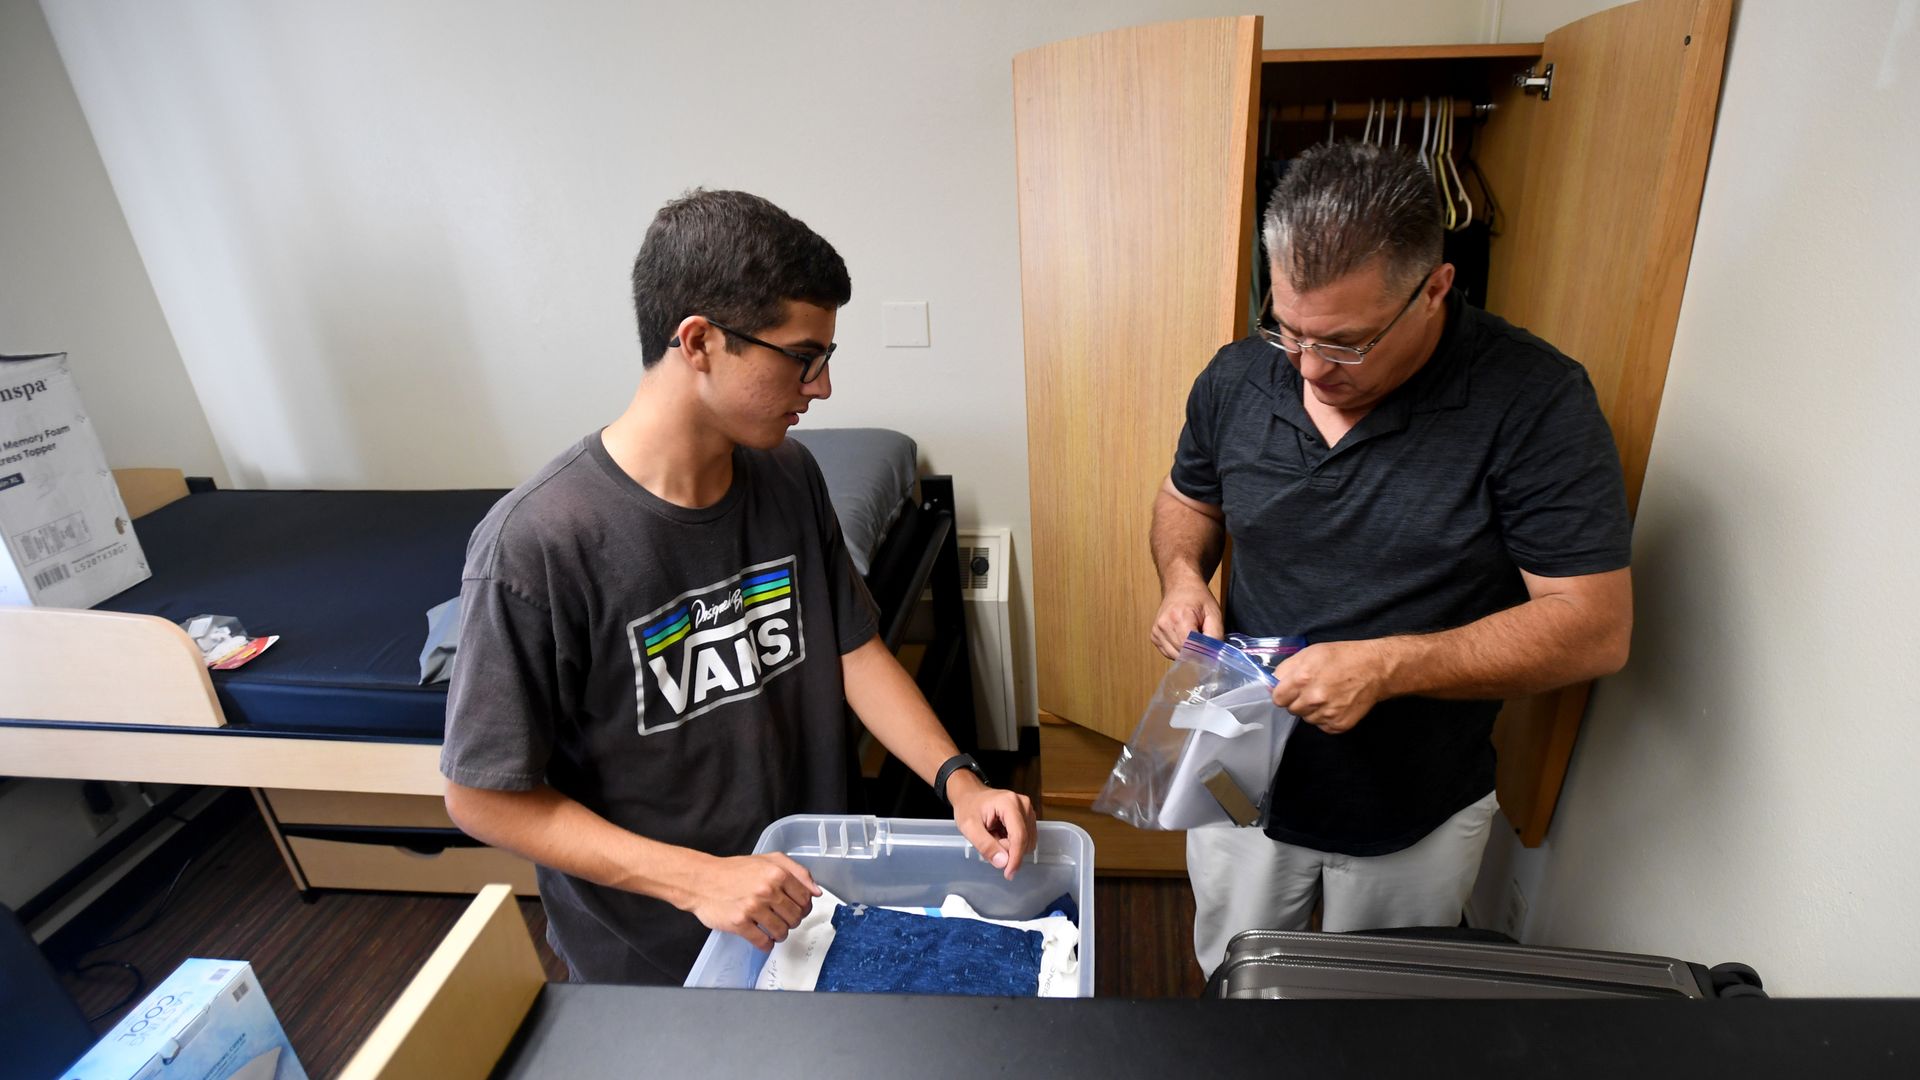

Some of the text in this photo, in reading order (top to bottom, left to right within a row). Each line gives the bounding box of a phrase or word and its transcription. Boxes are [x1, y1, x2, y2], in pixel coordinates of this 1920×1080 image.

[3, 425, 71, 450] Memory Foam
[22, 442, 56, 458] Topper
[690, 591, 731, 629] Designed
[648, 597, 793, 715] VANS
[117, 995, 175, 1041] COOL
